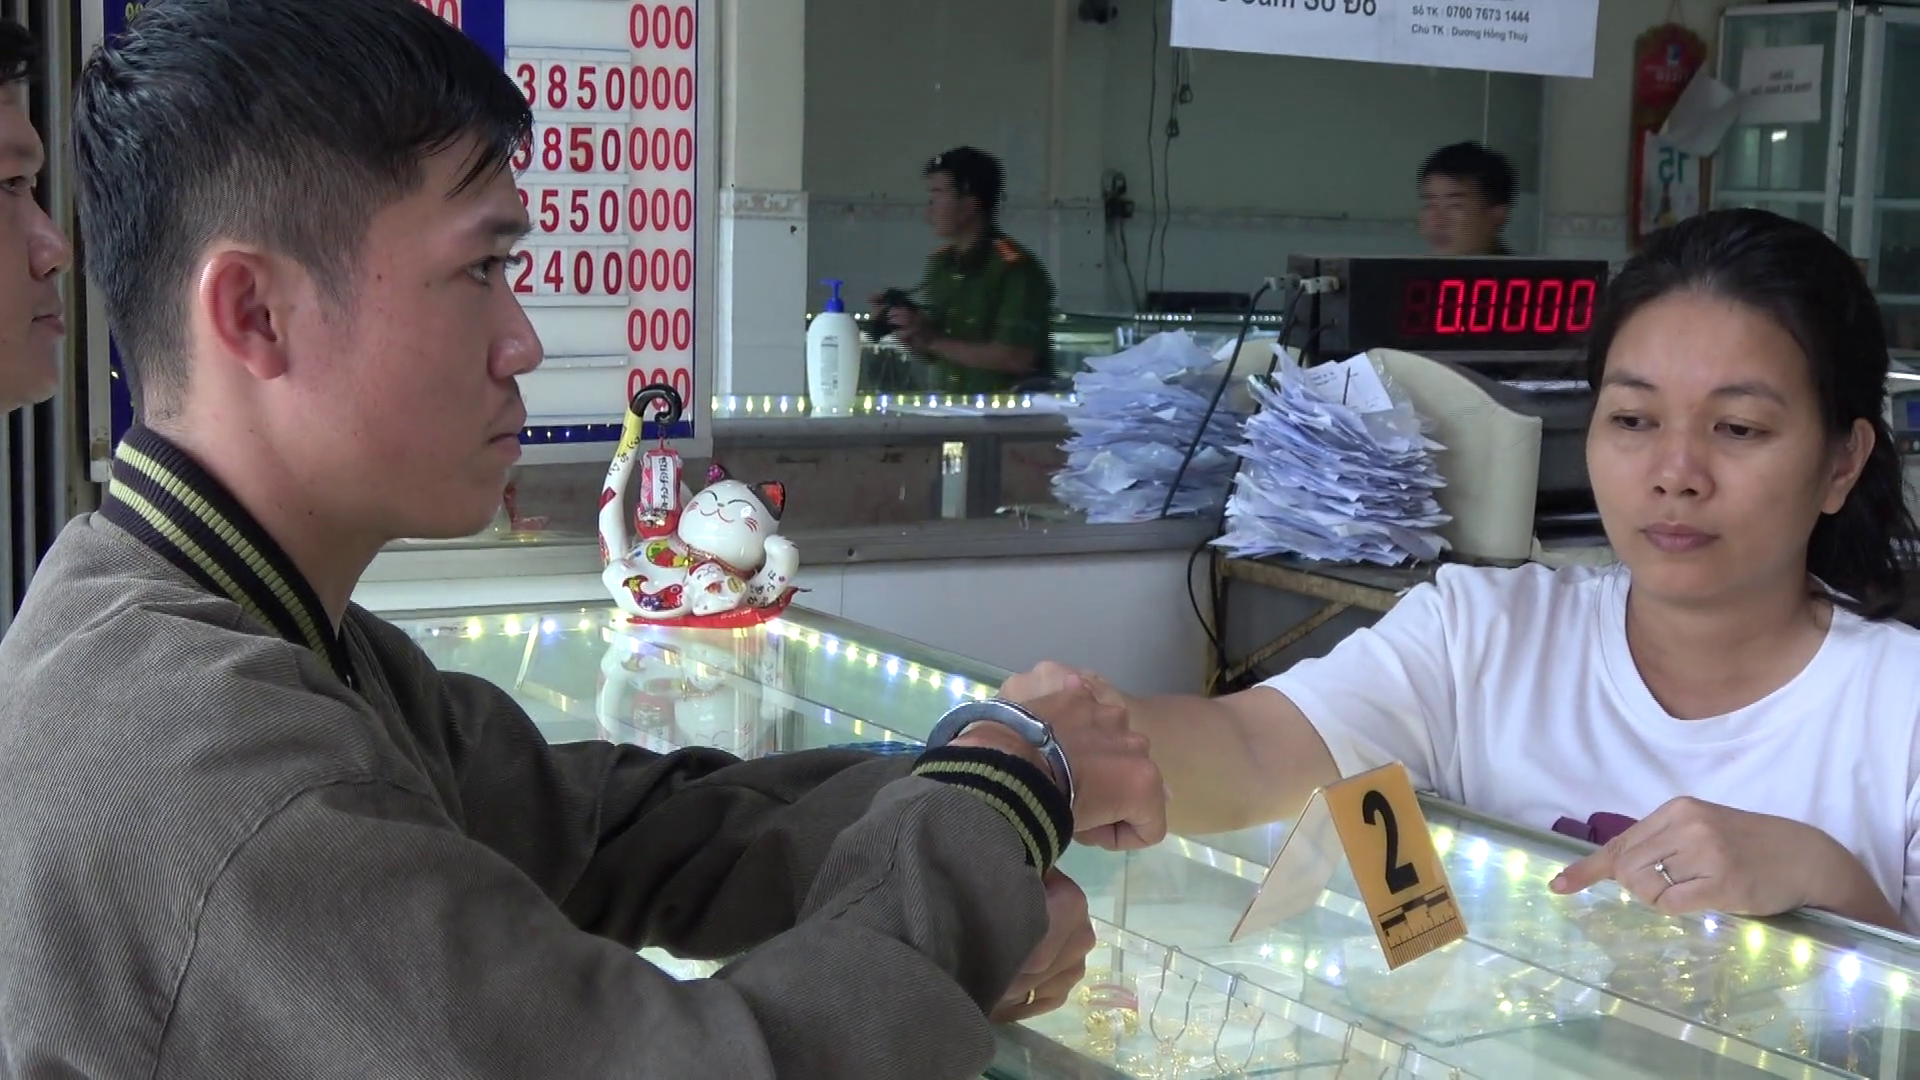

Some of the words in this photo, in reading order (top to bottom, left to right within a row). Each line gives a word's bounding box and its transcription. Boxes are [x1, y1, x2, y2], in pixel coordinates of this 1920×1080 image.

[630, 4, 694, 49] 000
[1426, 6, 1439, 17] TK
[1446, 5, 1473, 19] 0700
[1475, 7, 1501, 21] 7673
[1504, 10, 1530, 23] 1444
[1432, 24, 1444, 35] TK
[1436, 279, 1597, 334] 0.0000
[628, 308, 690, 352] 000
[1362, 790, 1419, 895] 2
